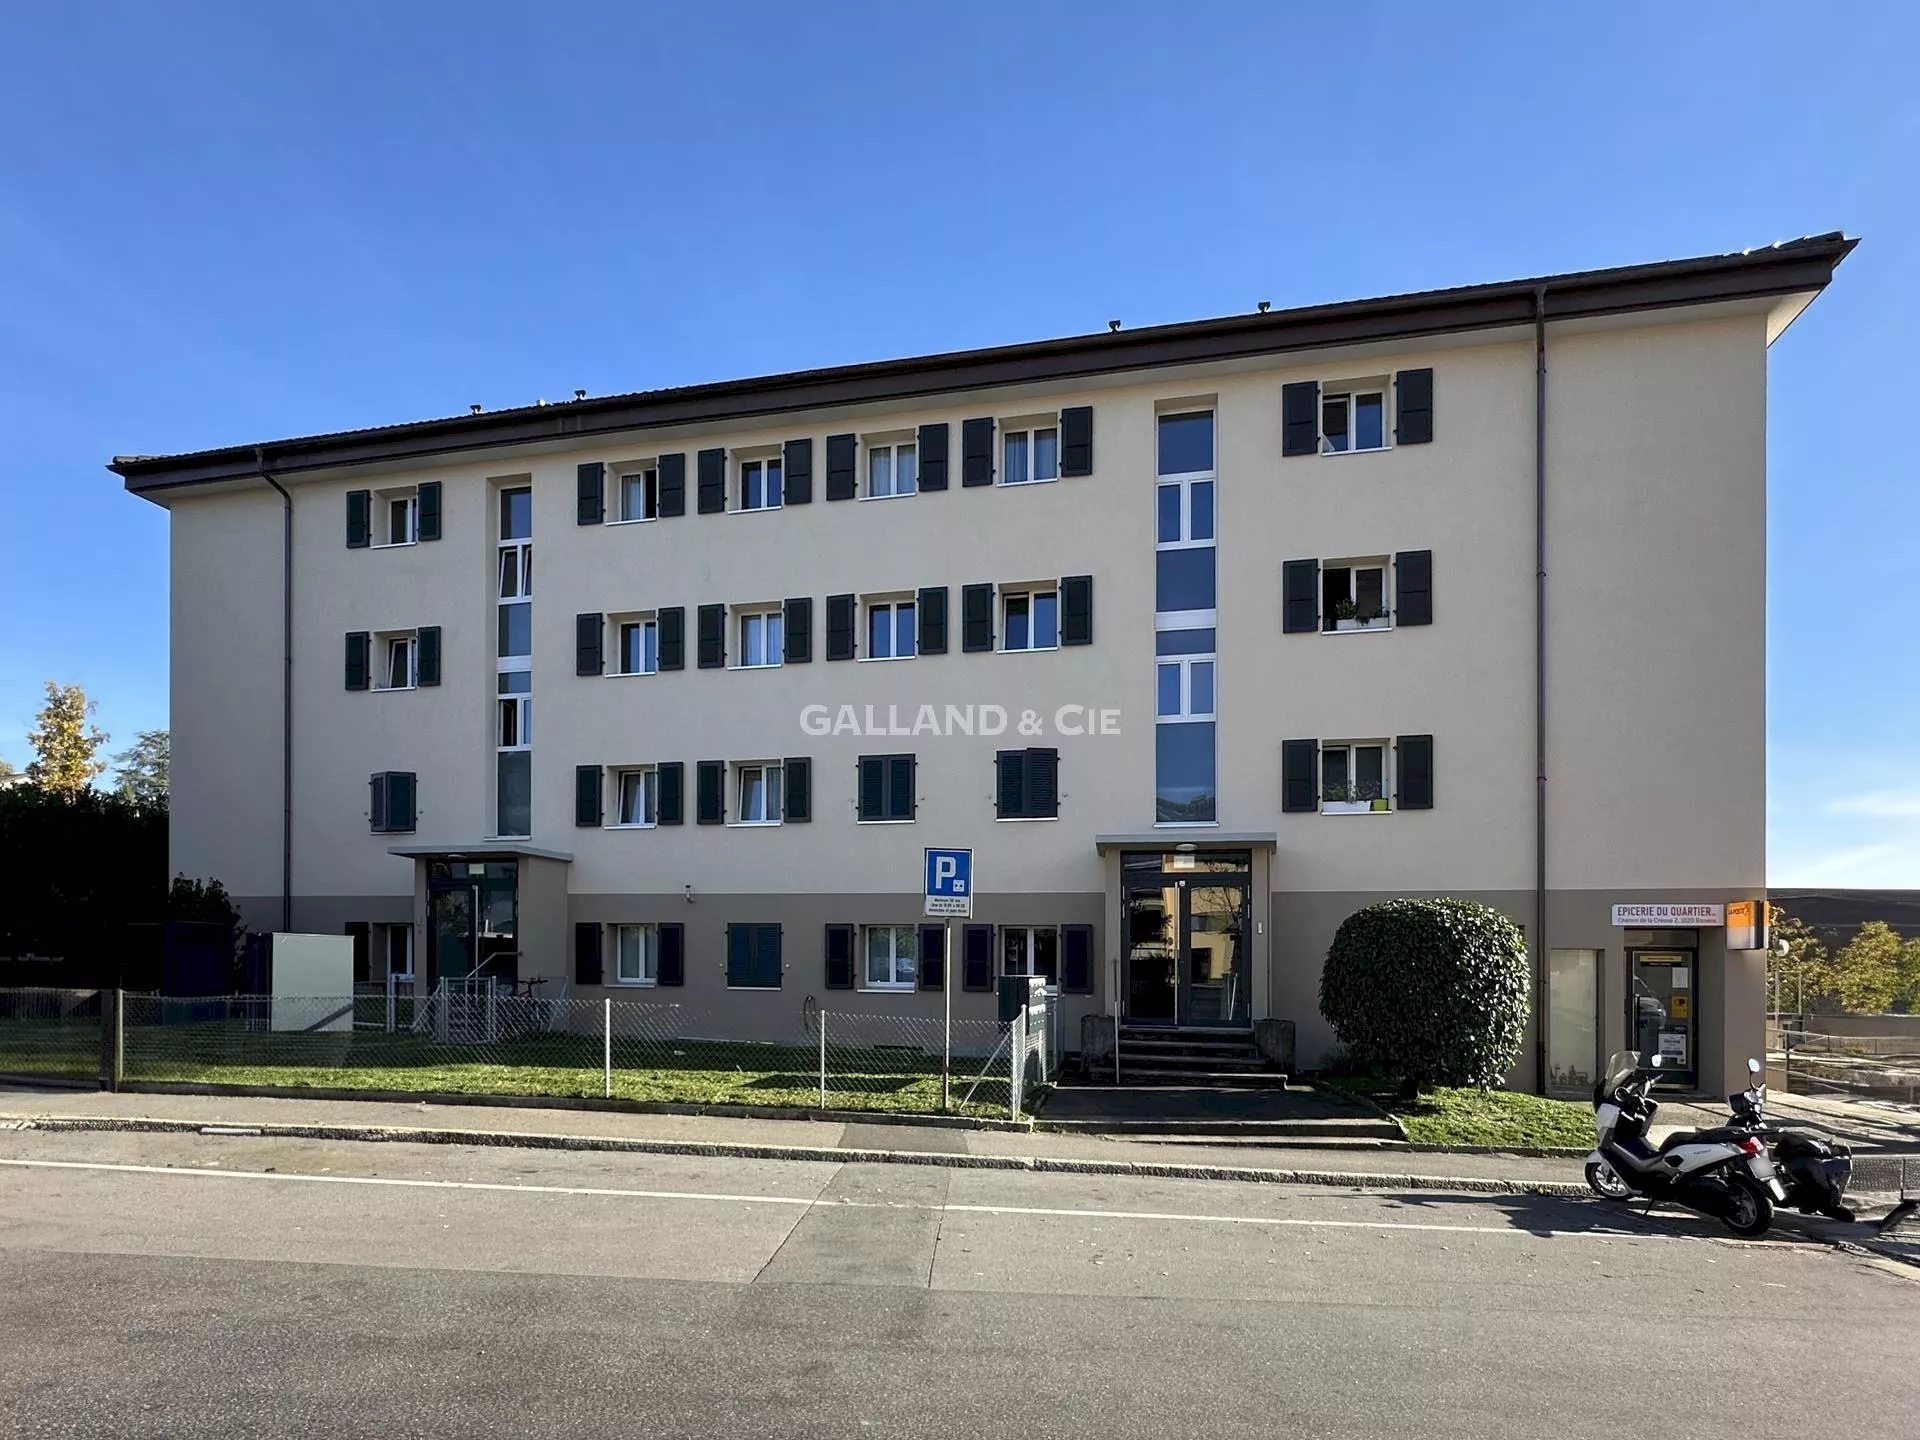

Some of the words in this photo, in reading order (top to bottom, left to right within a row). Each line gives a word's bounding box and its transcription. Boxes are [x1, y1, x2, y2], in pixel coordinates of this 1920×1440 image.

[935, 856, 956, 889] P
[1617, 906, 1654, 917] EPICERIE
[1656, 906, 1668, 917] DU
